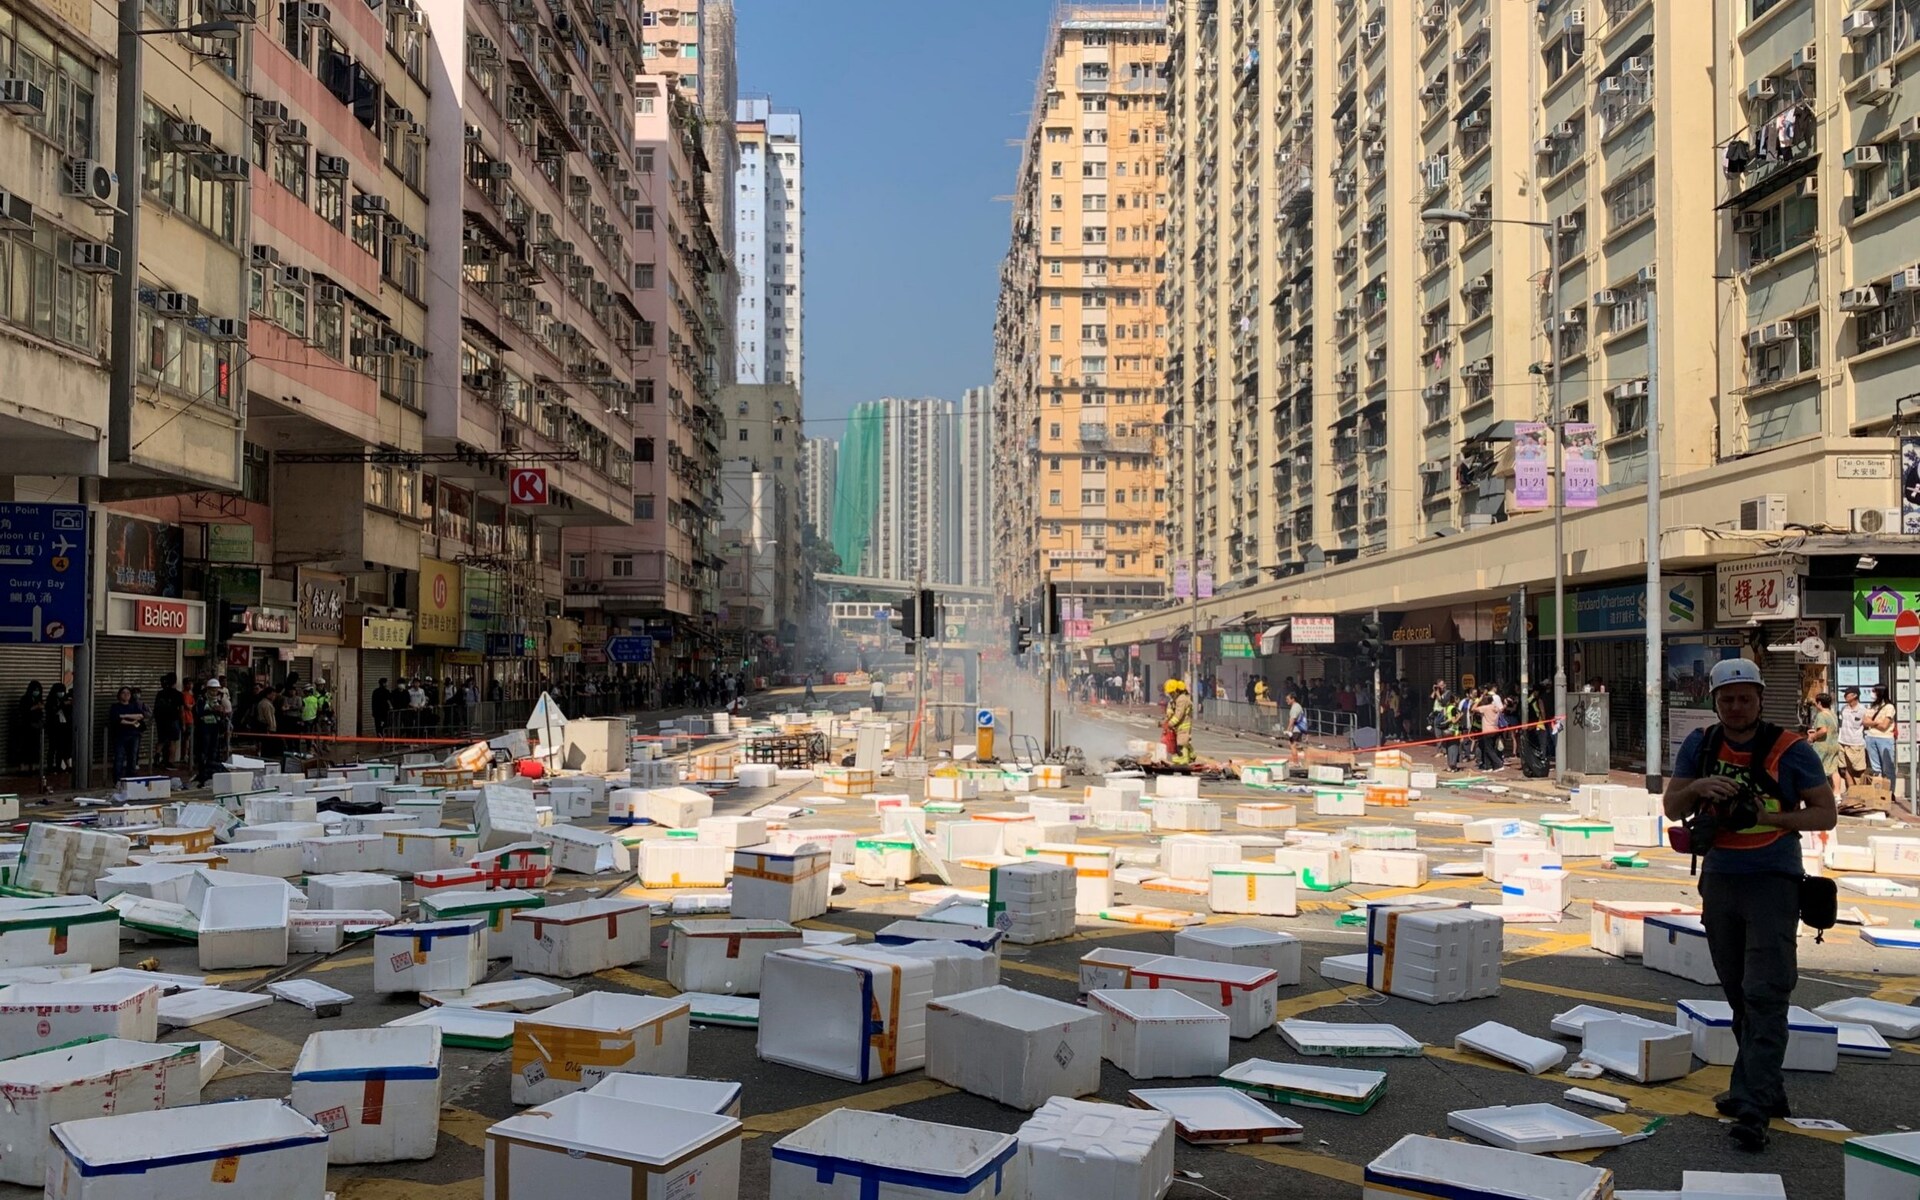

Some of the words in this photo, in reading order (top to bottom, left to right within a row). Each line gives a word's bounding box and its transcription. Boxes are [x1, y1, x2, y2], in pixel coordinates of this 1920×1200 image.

[1852, 467, 1877, 476] 大安街
[516, 474, 542, 499] K
[15, 505, 39, 515] Point
[9, 578, 42, 590] Quarry
[47, 579, 65, 590] Bay
[1571, 595, 1600, 612] Standard
[1600, 592, 1635, 609] Chartered
[144, 604, 184, 628] Baleno
